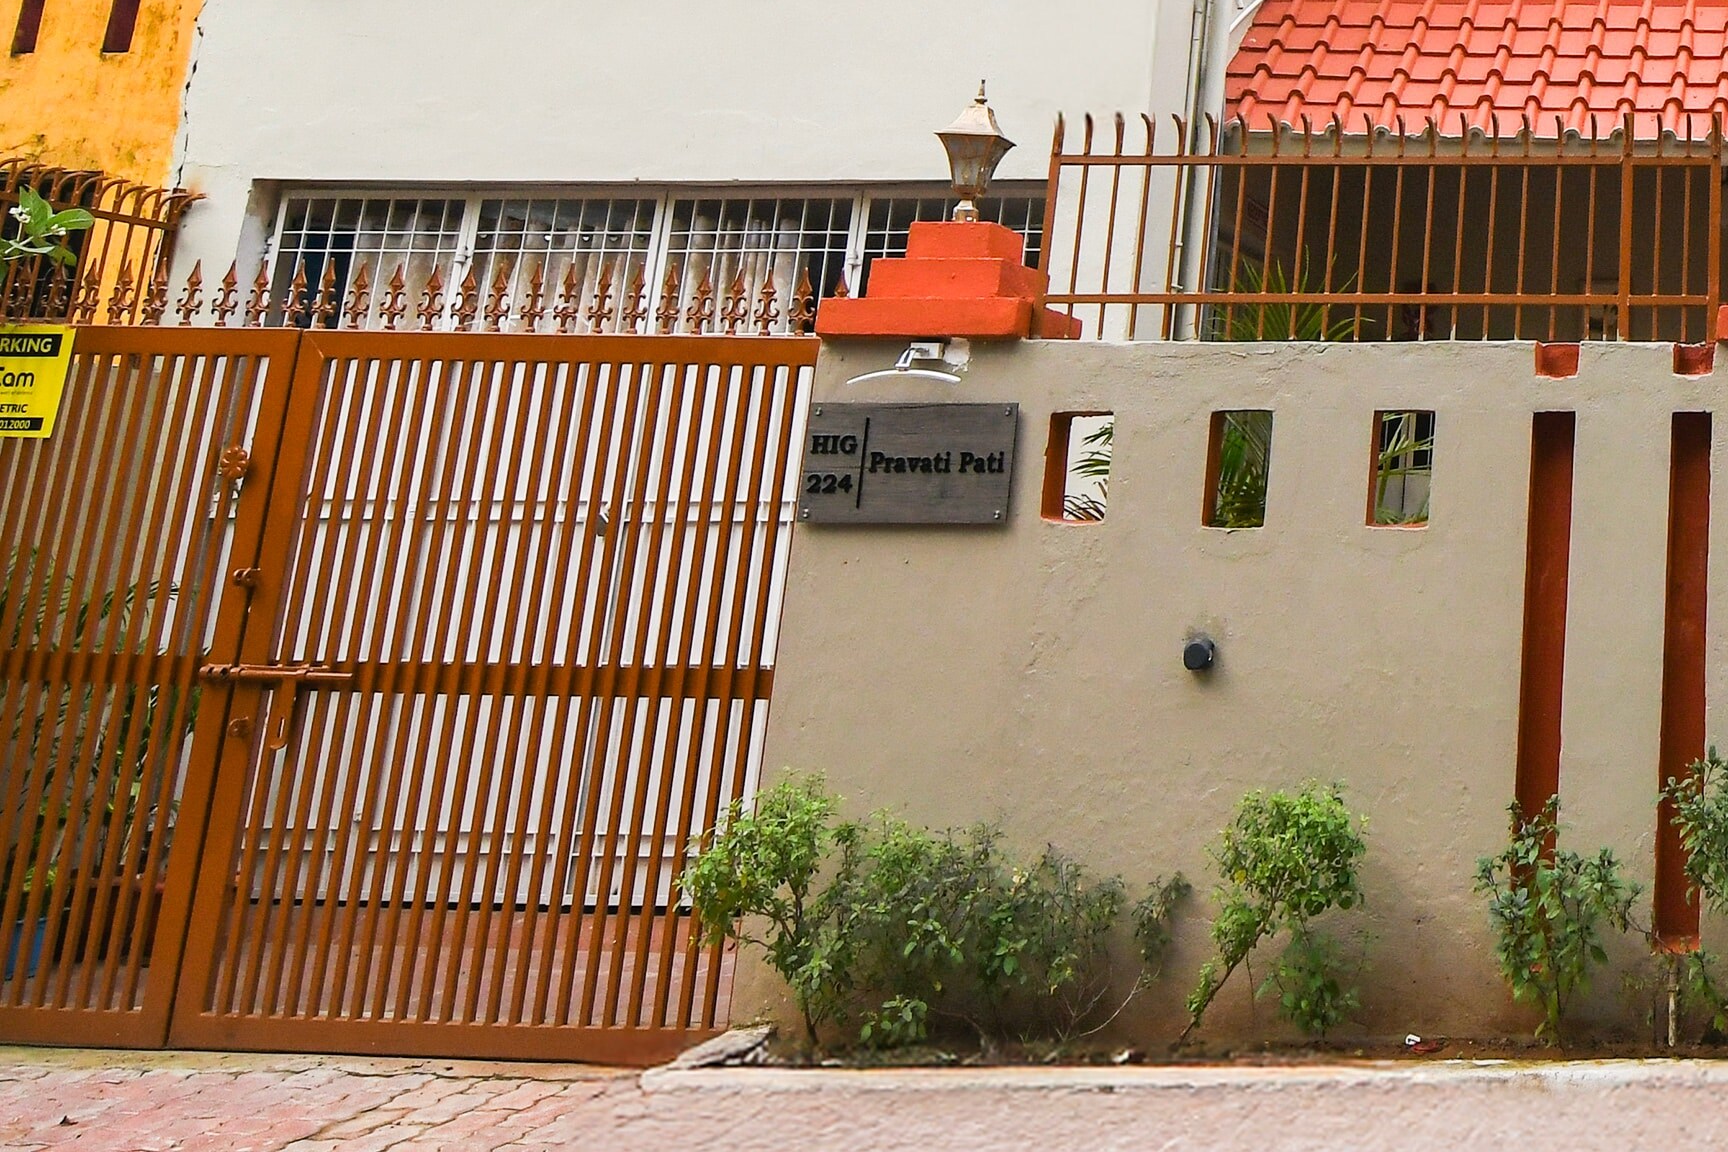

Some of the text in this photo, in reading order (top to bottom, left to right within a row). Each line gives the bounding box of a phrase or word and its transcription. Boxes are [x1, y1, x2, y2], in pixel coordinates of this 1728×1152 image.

[810, 434, 858, 455] HIG
[868, 451, 1005, 474] Pravati Pati
[806, 473, 853, 494] 224
